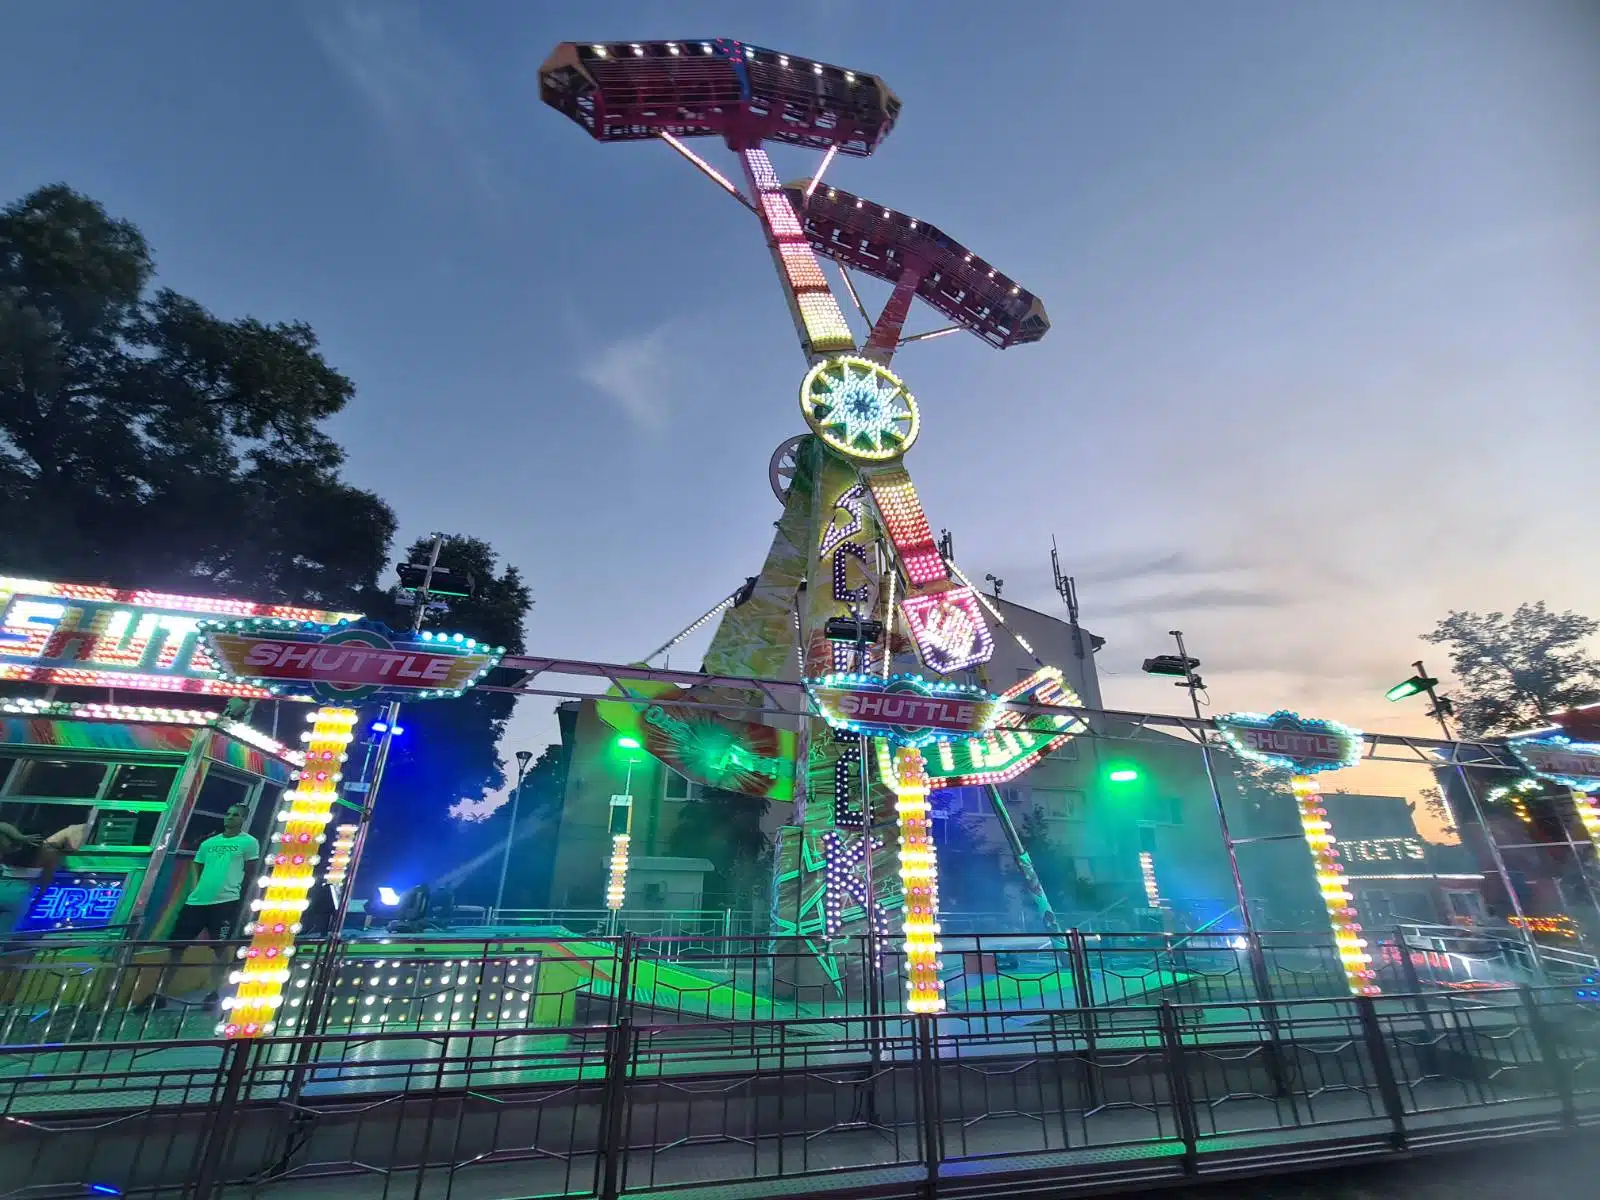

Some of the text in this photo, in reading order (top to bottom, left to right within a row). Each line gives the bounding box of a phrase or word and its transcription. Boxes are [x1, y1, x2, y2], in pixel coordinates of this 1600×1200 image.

[244, 643, 456, 681] SHUTTLE
[838, 695, 975, 724] SHUTTLE
[1242, 731, 1340, 754] SHUTTLE
